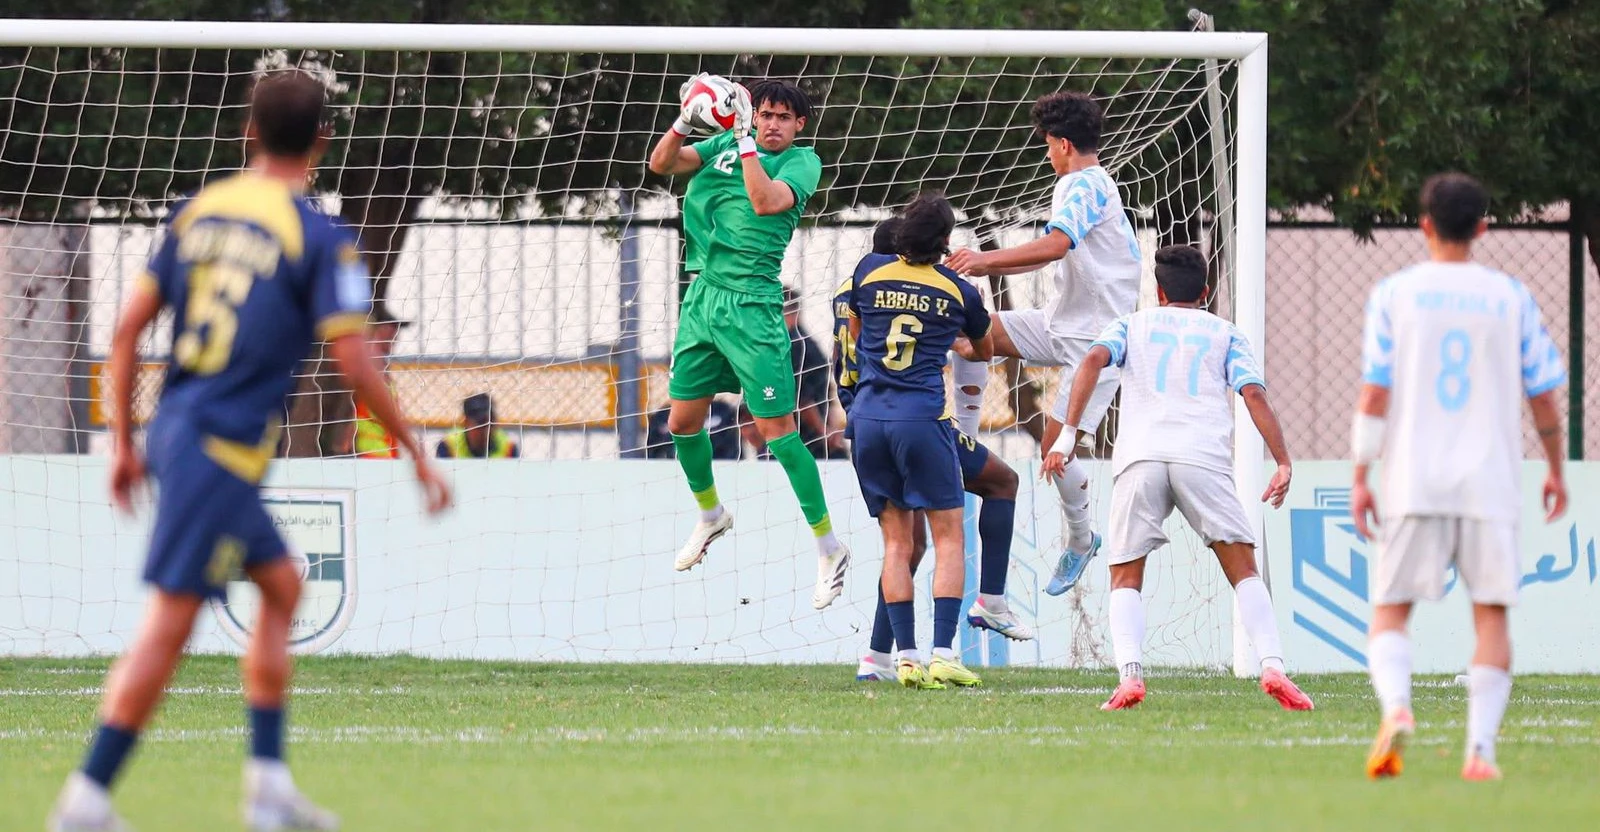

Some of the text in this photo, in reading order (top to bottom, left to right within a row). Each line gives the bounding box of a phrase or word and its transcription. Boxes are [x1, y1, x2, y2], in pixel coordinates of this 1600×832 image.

[713, 150, 738, 175] 12
[175, 262, 254, 376] 5
[873, 289, 931, 313] ABBAS
[936, 297, 950, 317] Y.
[881, 313, 924, 372] 6
[1149, 331, 1212, 397] 77
[1435, 328, 1473, 413] 8
